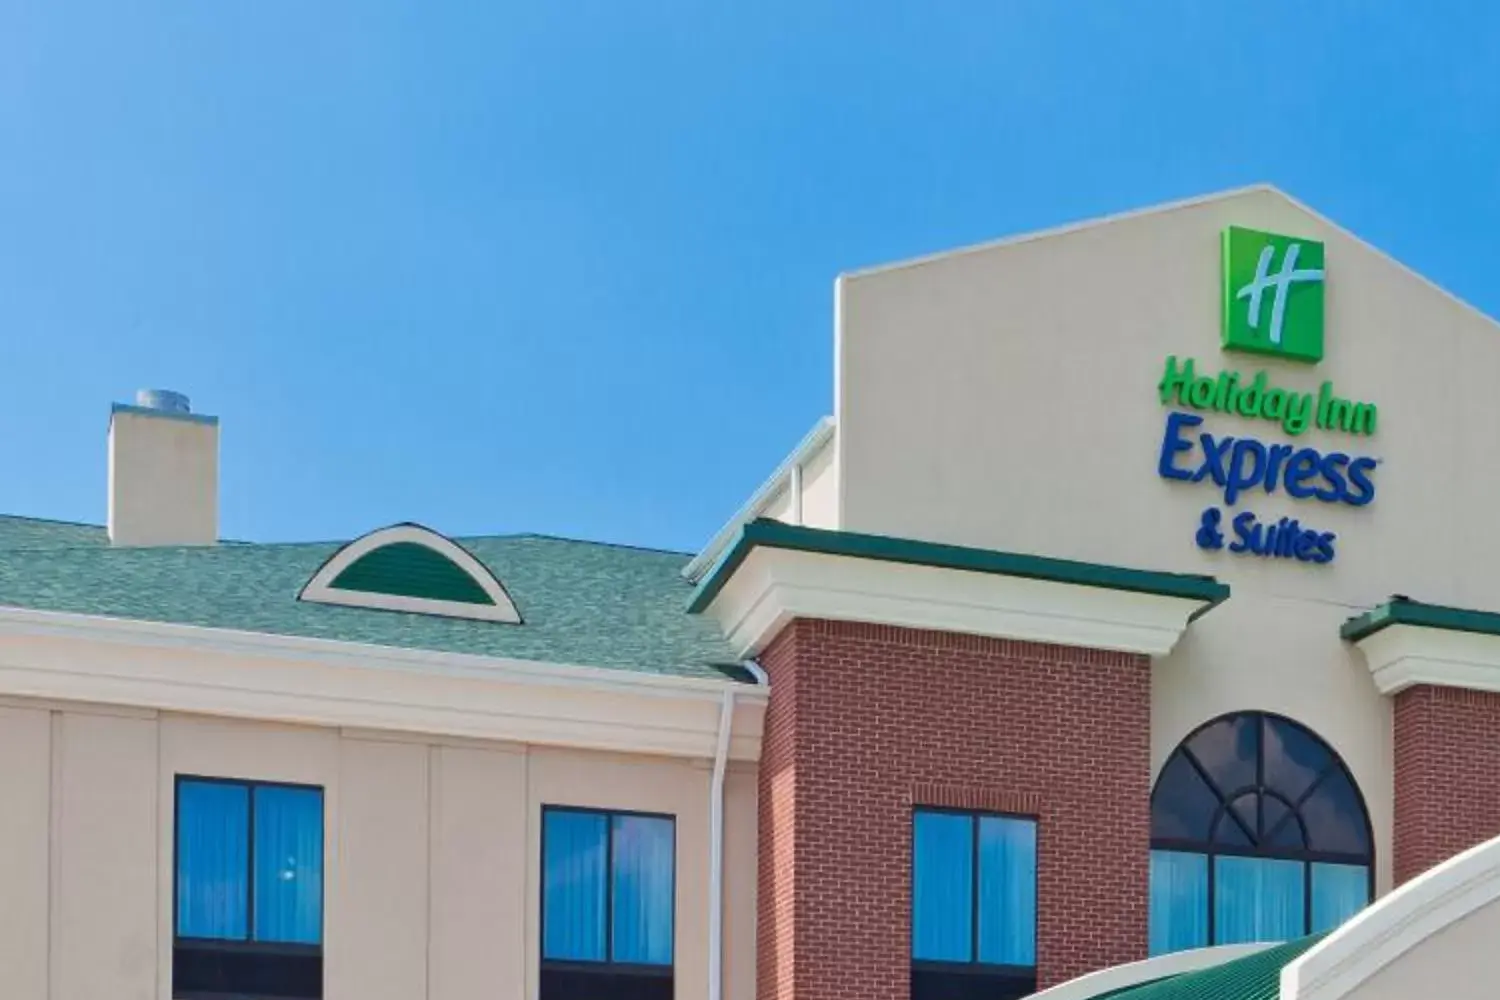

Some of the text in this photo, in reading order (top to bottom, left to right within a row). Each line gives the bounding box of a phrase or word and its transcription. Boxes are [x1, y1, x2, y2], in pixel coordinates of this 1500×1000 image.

[1159, 355, 1378, 435] Holiday Inn
[1158, 411, 1378, 506] Express
[1196, 507, 1337, 564] & Suites
